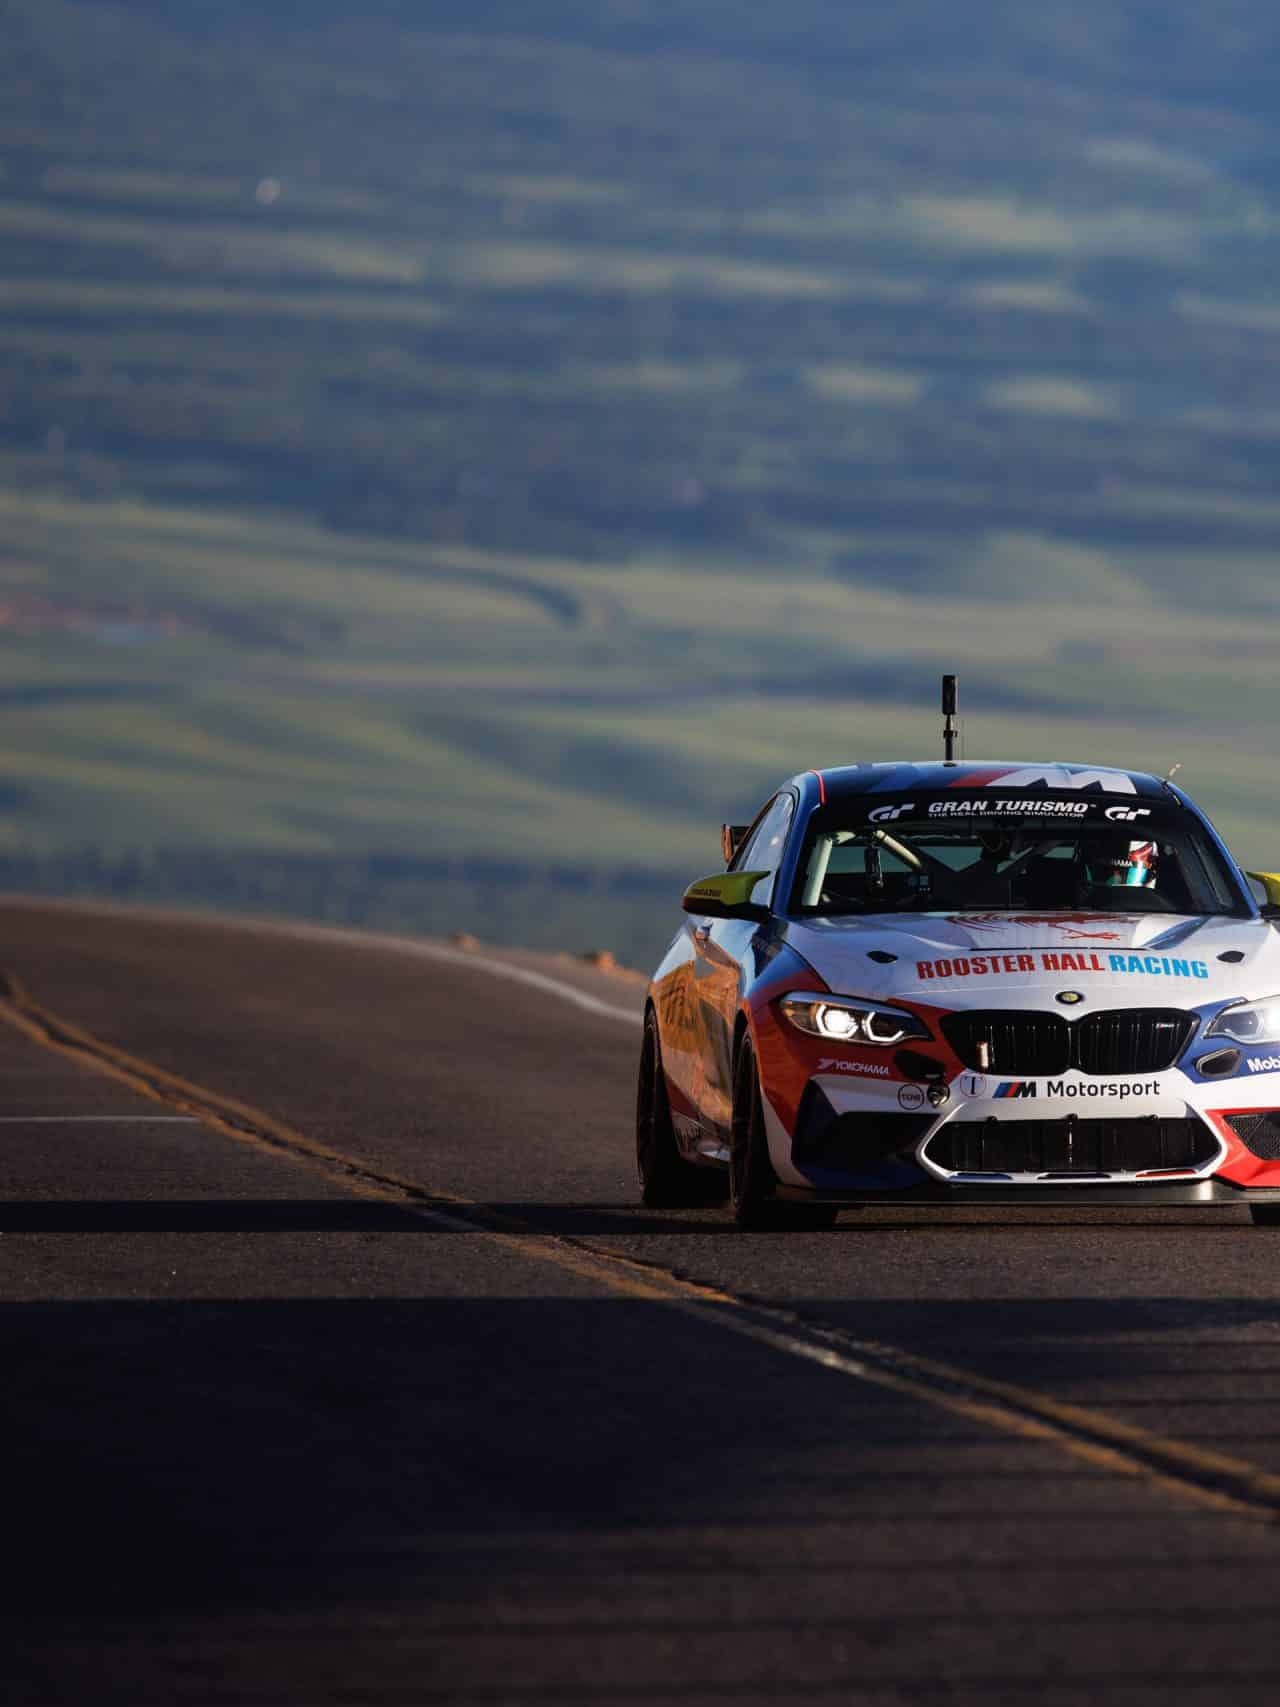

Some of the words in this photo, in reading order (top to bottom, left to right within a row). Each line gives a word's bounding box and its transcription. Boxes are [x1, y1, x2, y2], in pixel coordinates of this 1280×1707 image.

[927, 801, 988, 813] GRAN
[994, 800, 1089, 814] TURISMO
[1024, 811, 1085, 819] SIMULATOR
[916, 953, 1036, 981] ROOSTER
[1041, 951, 1105, 972] HALL
[1108, 953, 1210, 980] RACING
[834, 1060, 889, 1075] YOKOHAMA
[1046, 1080, 1161, 1100] Motorsport
